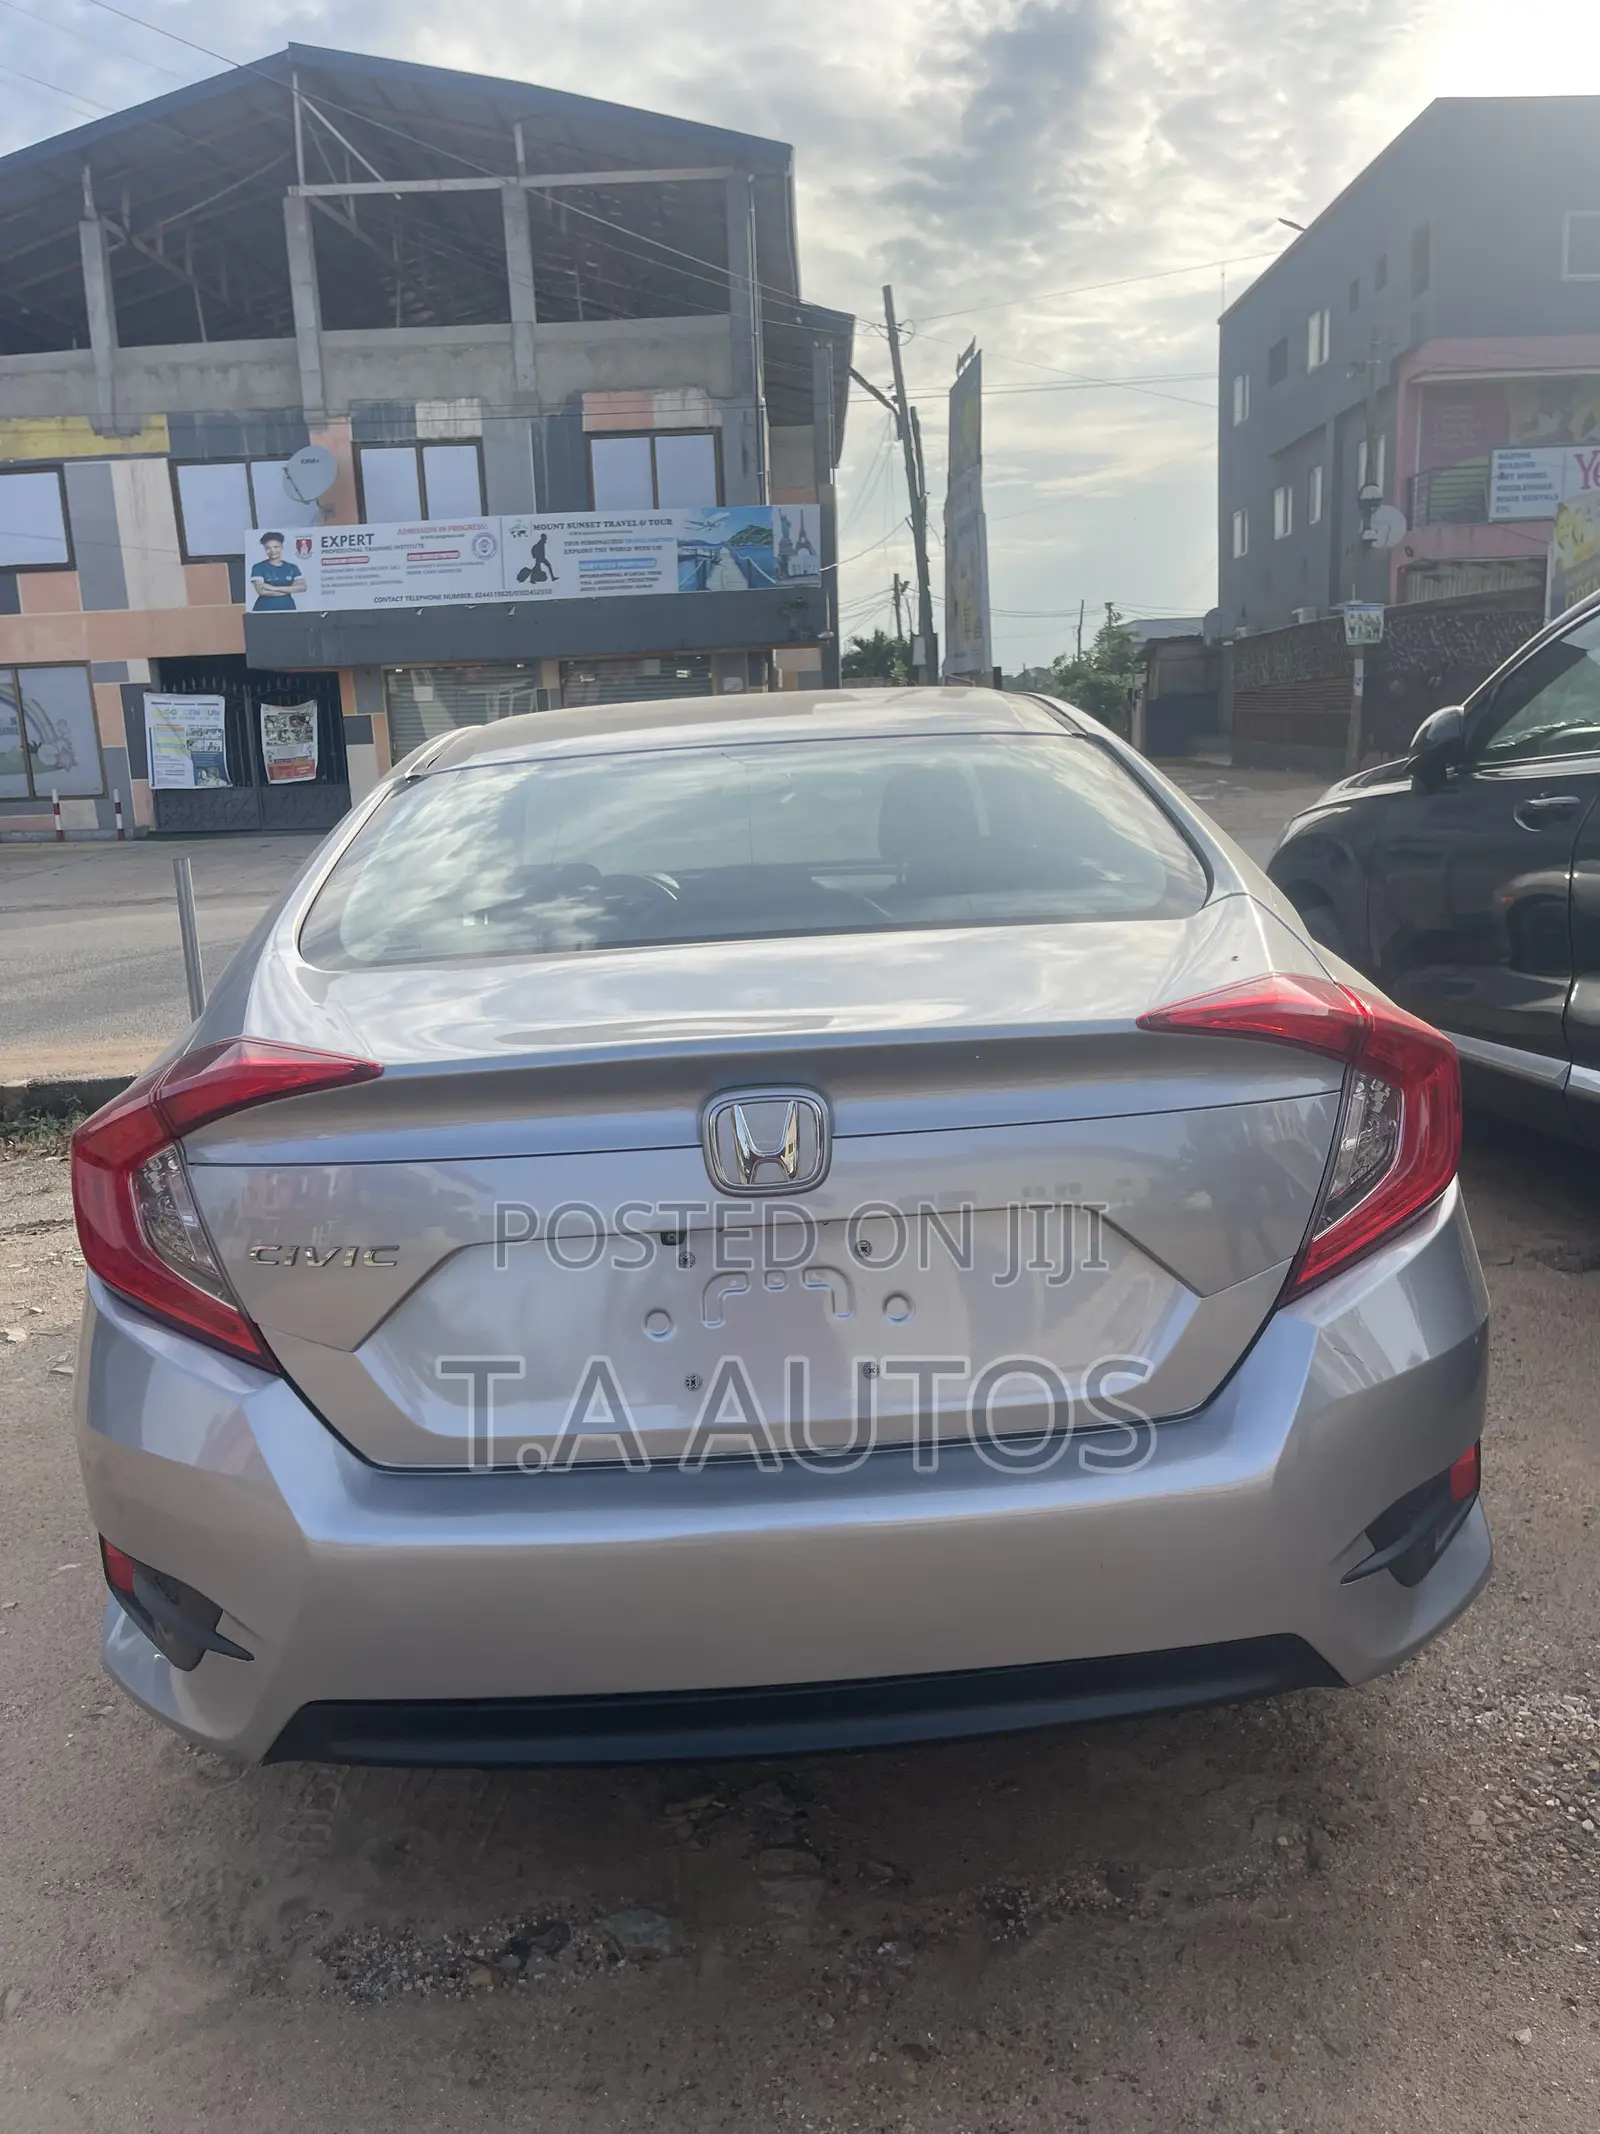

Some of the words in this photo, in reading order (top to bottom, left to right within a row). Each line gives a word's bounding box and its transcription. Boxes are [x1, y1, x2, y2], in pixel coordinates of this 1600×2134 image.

[397, 526, 437, 535] ADMISSION
[533, 523, 565, 531] MOUNT
[567, 521, 602, 529] SUNSET
[603, 520, 638, 528] TRAVEL
[321, 533, 375, 548] EXPERT
[374, 595, 403, 603] CONTACT
[405, 593, 442, 602] TELEPHONE
[250, 1245, 400, 1267] CIVIC
